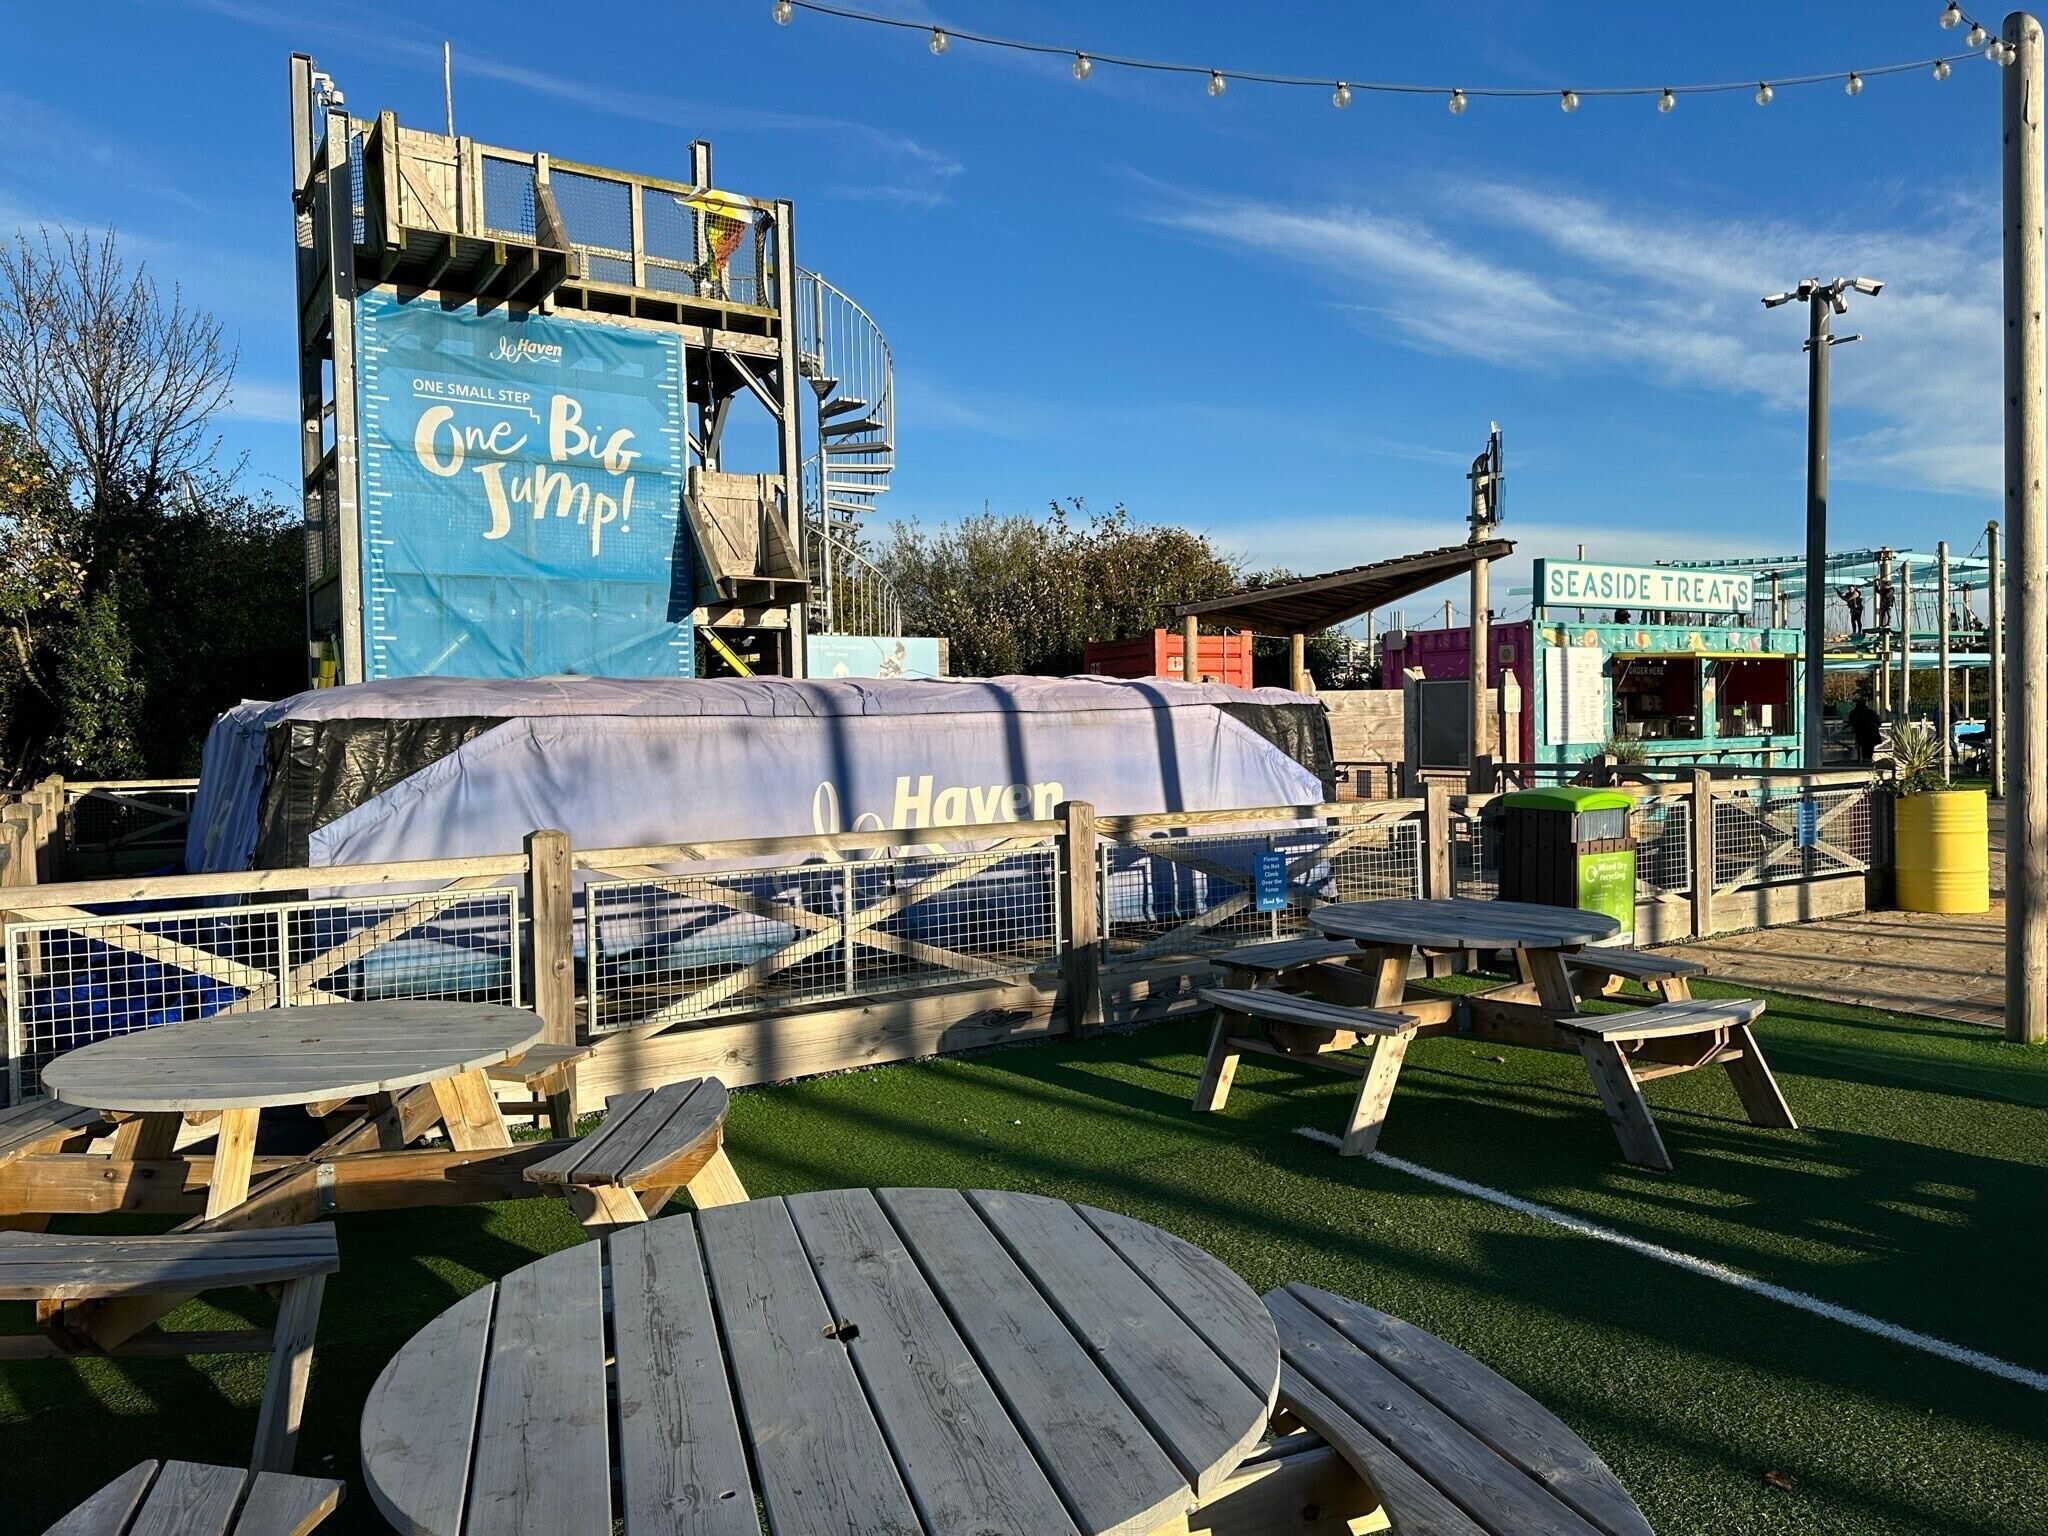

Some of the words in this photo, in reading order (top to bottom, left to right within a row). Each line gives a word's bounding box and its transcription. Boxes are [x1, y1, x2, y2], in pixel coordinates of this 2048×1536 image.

[517, 338, 563, 357] Haven
[412, 378, 444, 393] ONE
[447, 383, 496, 400] SMALL
[498, 389, 531, 404] STEP
[414, 405, 527, 477] One
[472, 461, 635, 557] Jump!
[1550, 568, 1650, 600] SEASIDE
[1661, 576, 1749, 606] TREATS
[1629, 666, 1648, 675] ORDER
[892, 775, 1064, 829] Haven
[1599, 862, 1616, 871] Mixed
[1600, 872, 1626, 881] recycling
